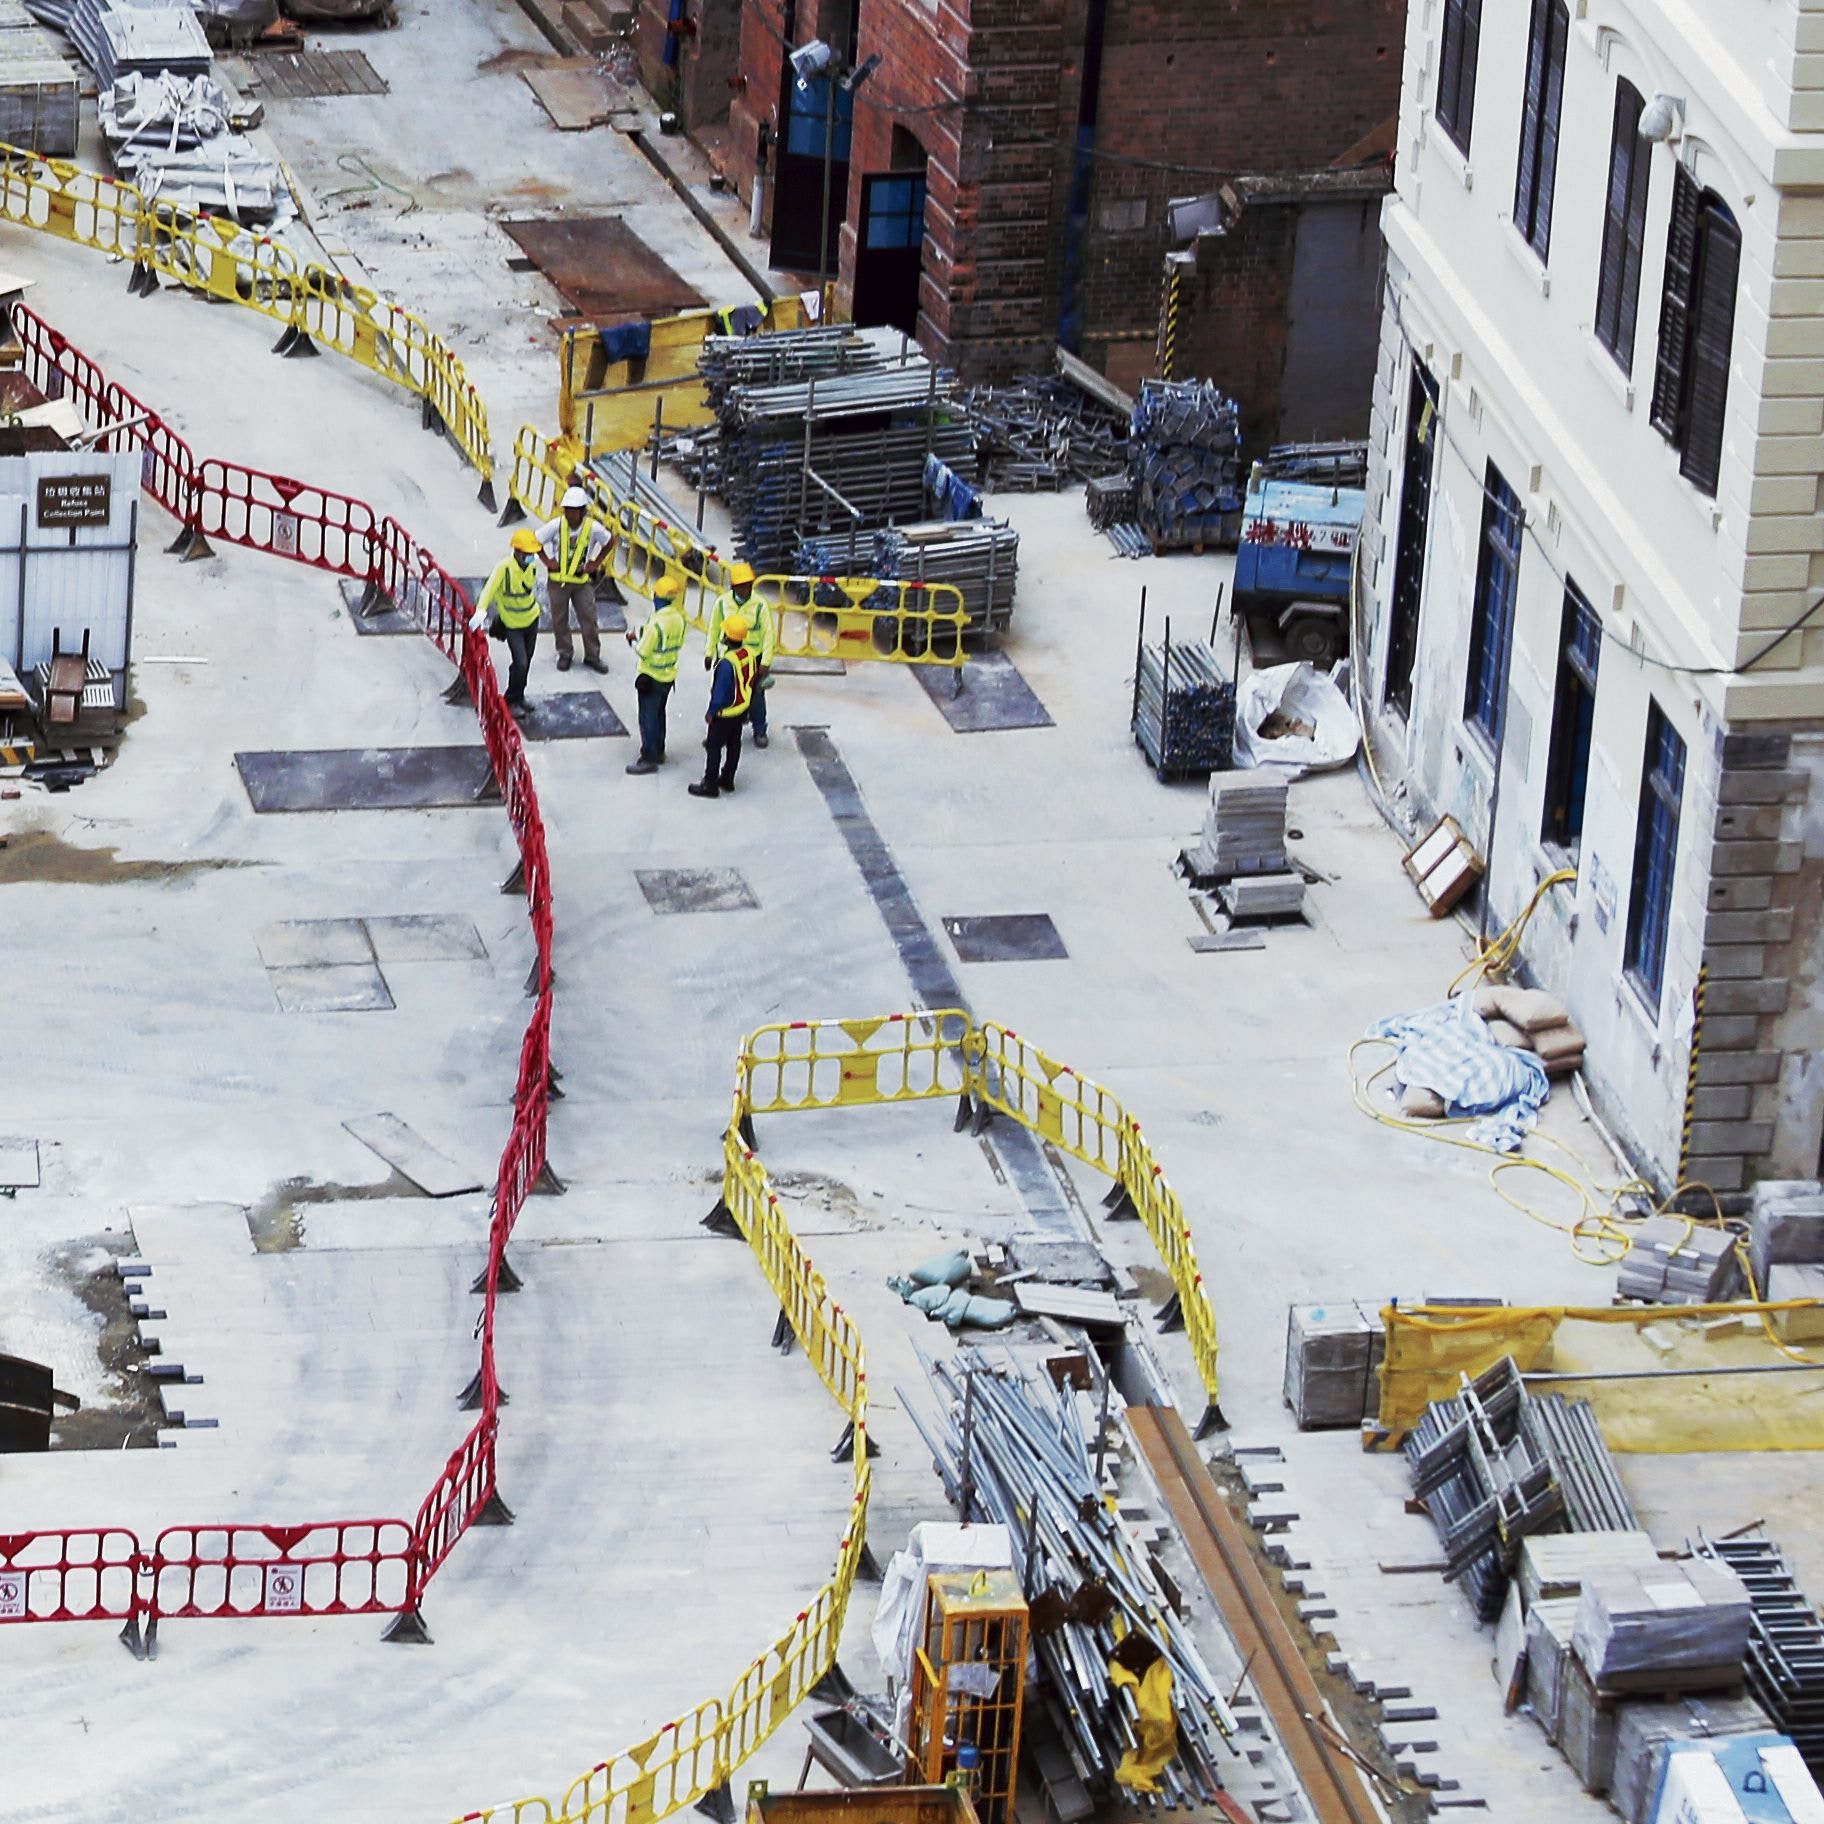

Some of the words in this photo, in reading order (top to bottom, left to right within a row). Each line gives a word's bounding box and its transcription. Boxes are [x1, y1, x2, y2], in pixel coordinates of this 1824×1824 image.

[45, 484, 105, 496] 垃圾收集站
[61, 498, 87, 507] Refuse
[43, 509, 83, 518] Collection
[84, 508, 105, 517] Point
